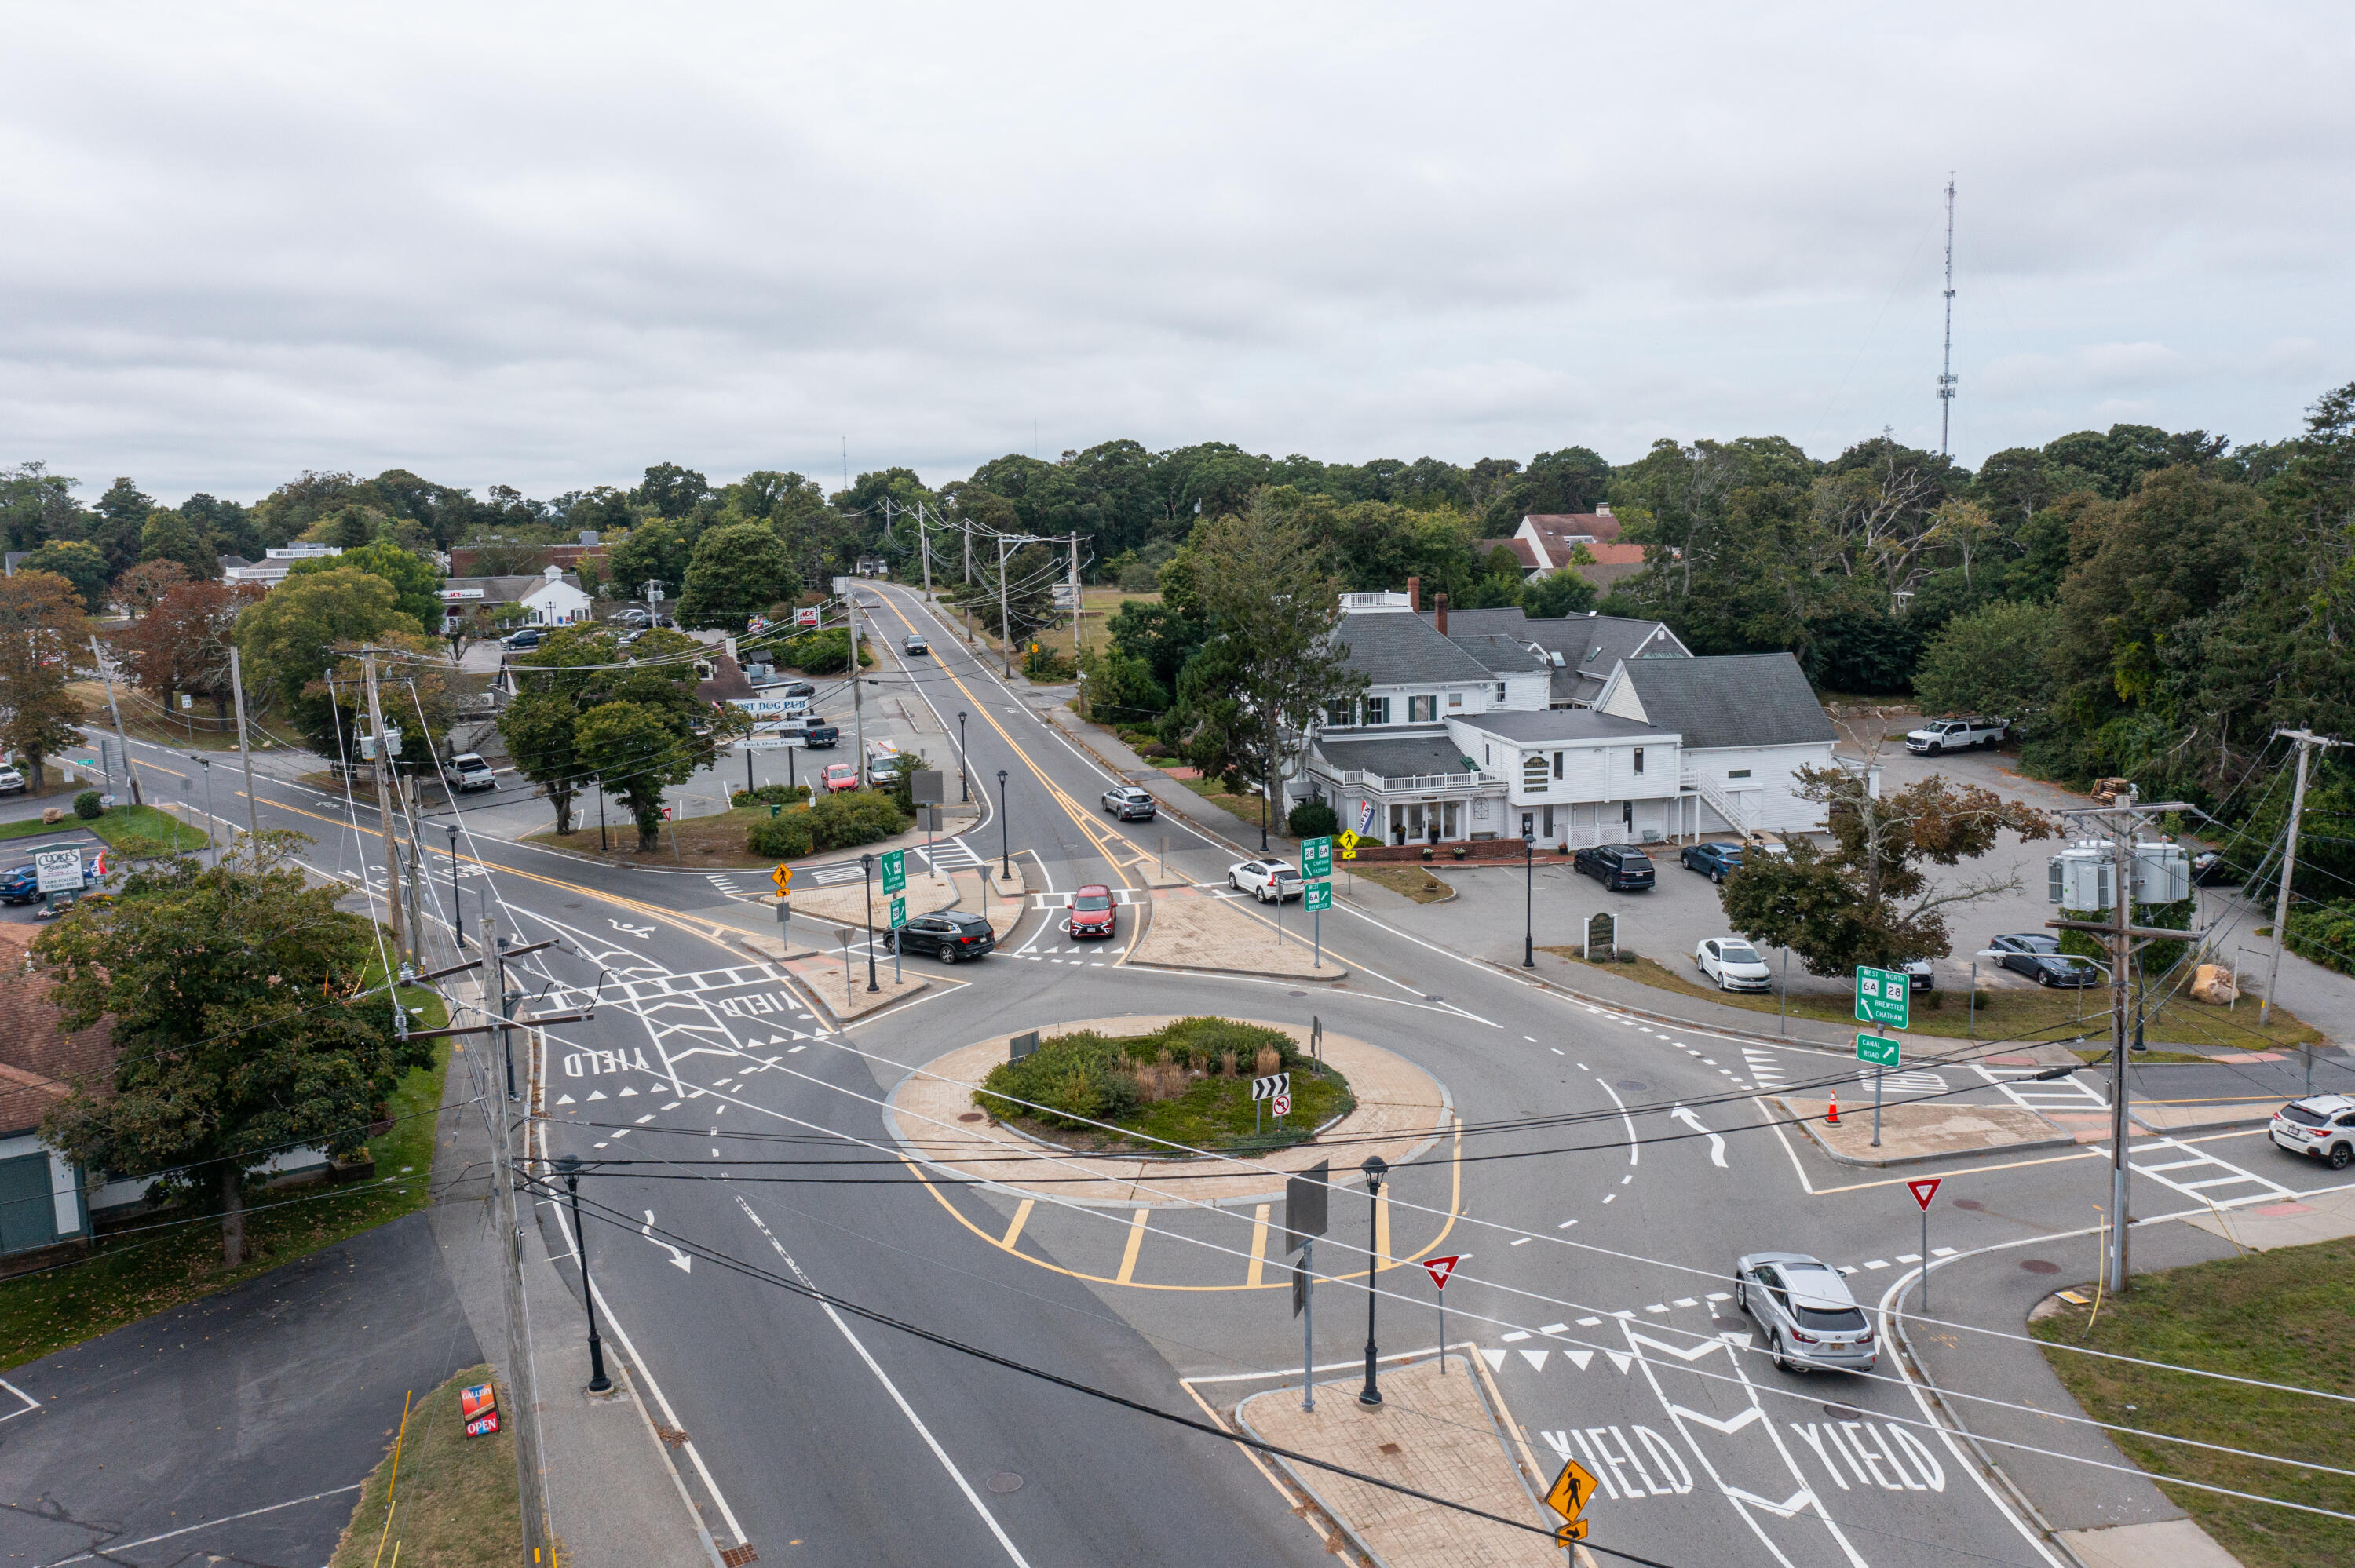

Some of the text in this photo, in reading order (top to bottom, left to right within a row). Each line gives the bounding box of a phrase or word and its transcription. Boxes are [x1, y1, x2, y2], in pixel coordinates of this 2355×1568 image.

[758, 702, 780, 710] DOG
[783, 700, 805, 709] PUB
[1864, 968, 1904, 983] WEST NORTH
[1864, 982, 1901, 997] 6A 28
[1875, 1000, 1904, 1011] BREWSTER
[1875, 1011, 1902, 1021] CHATHAM
[1862, 1039, 1881, 1048] CANAL
[1864, 1050, 1879, 1059] ROAD
[564, 1048, 651, 1078] YIELD
[462, 1387, 491, 1400] GALLERY
[467, 1418, 496, 1434] OPEN
[1791, 1421, 1945, 1493] YIELD
